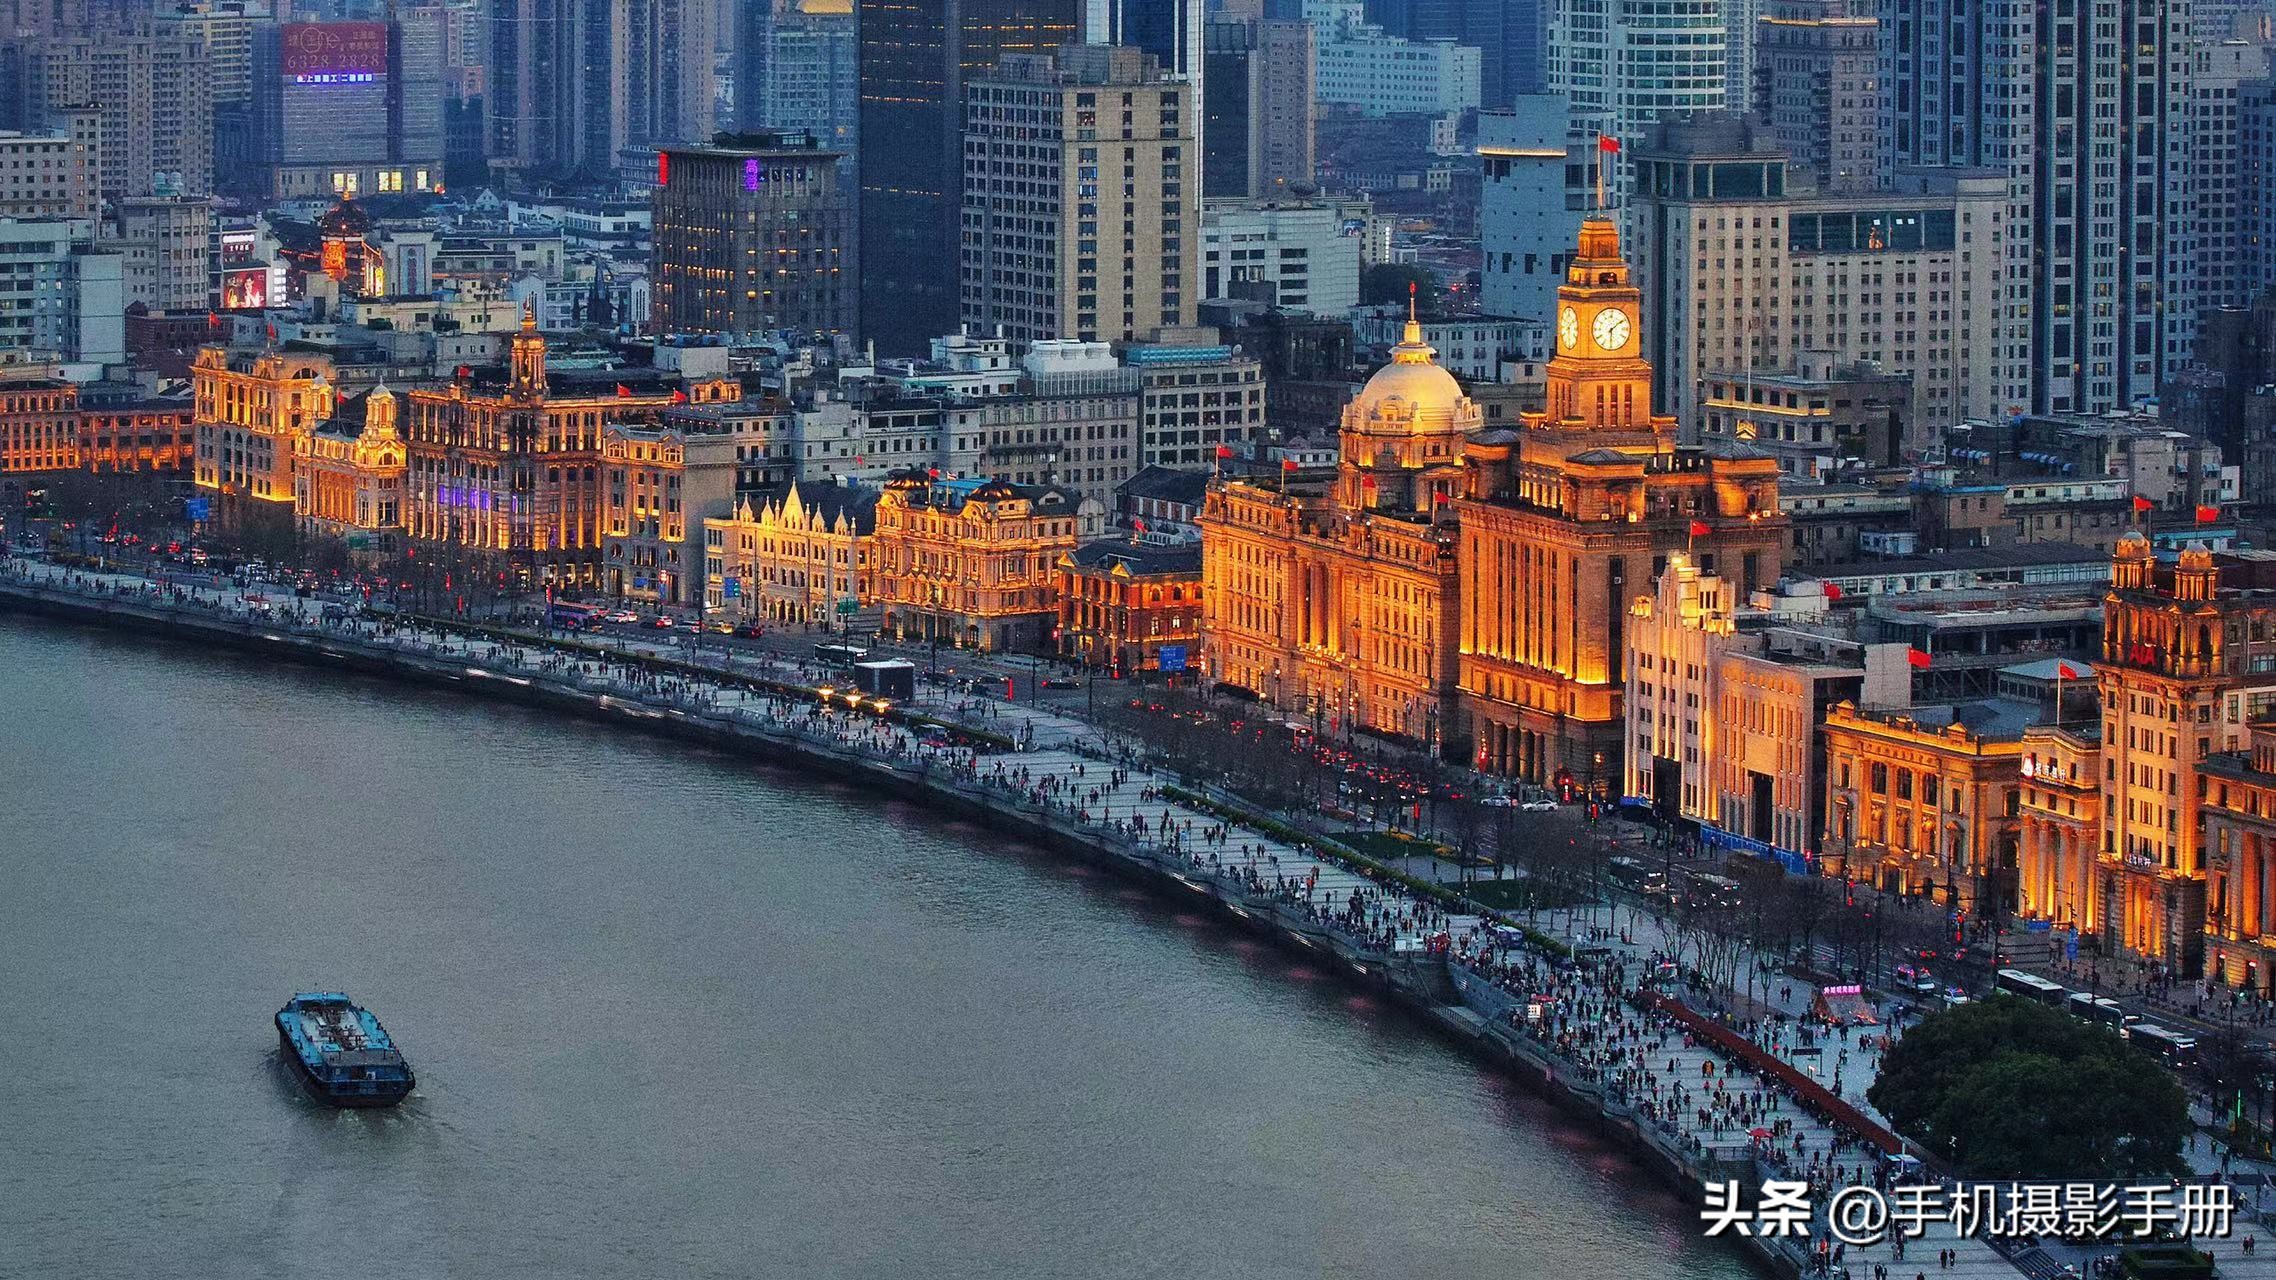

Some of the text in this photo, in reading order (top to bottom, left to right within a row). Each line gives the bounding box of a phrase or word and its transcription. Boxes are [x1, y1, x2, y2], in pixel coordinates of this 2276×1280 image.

[287, 54, 379, 68] 6328 2828
[2130, 644, 2156, 666] AIA
